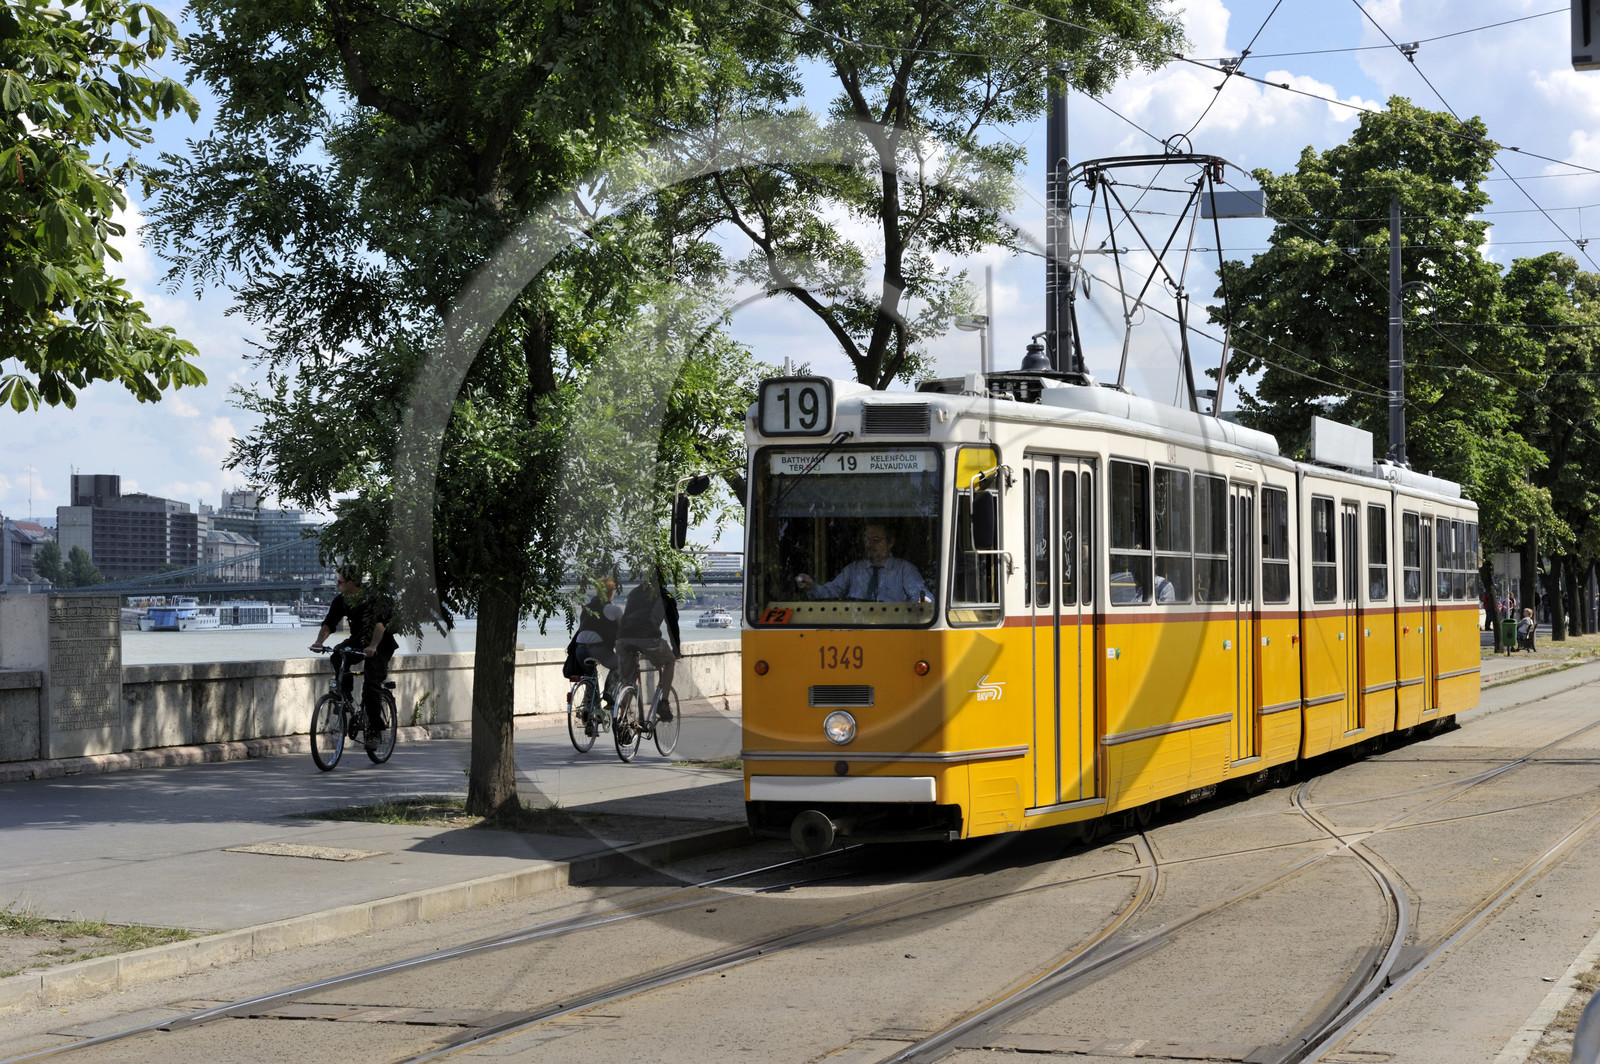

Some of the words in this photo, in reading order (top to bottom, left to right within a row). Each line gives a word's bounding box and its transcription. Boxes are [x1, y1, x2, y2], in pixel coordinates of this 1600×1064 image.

[777, 387, 819, 429] 19
[837, 456, 857, 471] 19
[870, 454, 917, 462] KELENFÖLDI
[789, 463, 804, 471] TÉR
[870, 461, 918, 470] PÁLYAUDVAR
[765, 610, 786, 622] F2
[819, 646, 863, 669] 1349
